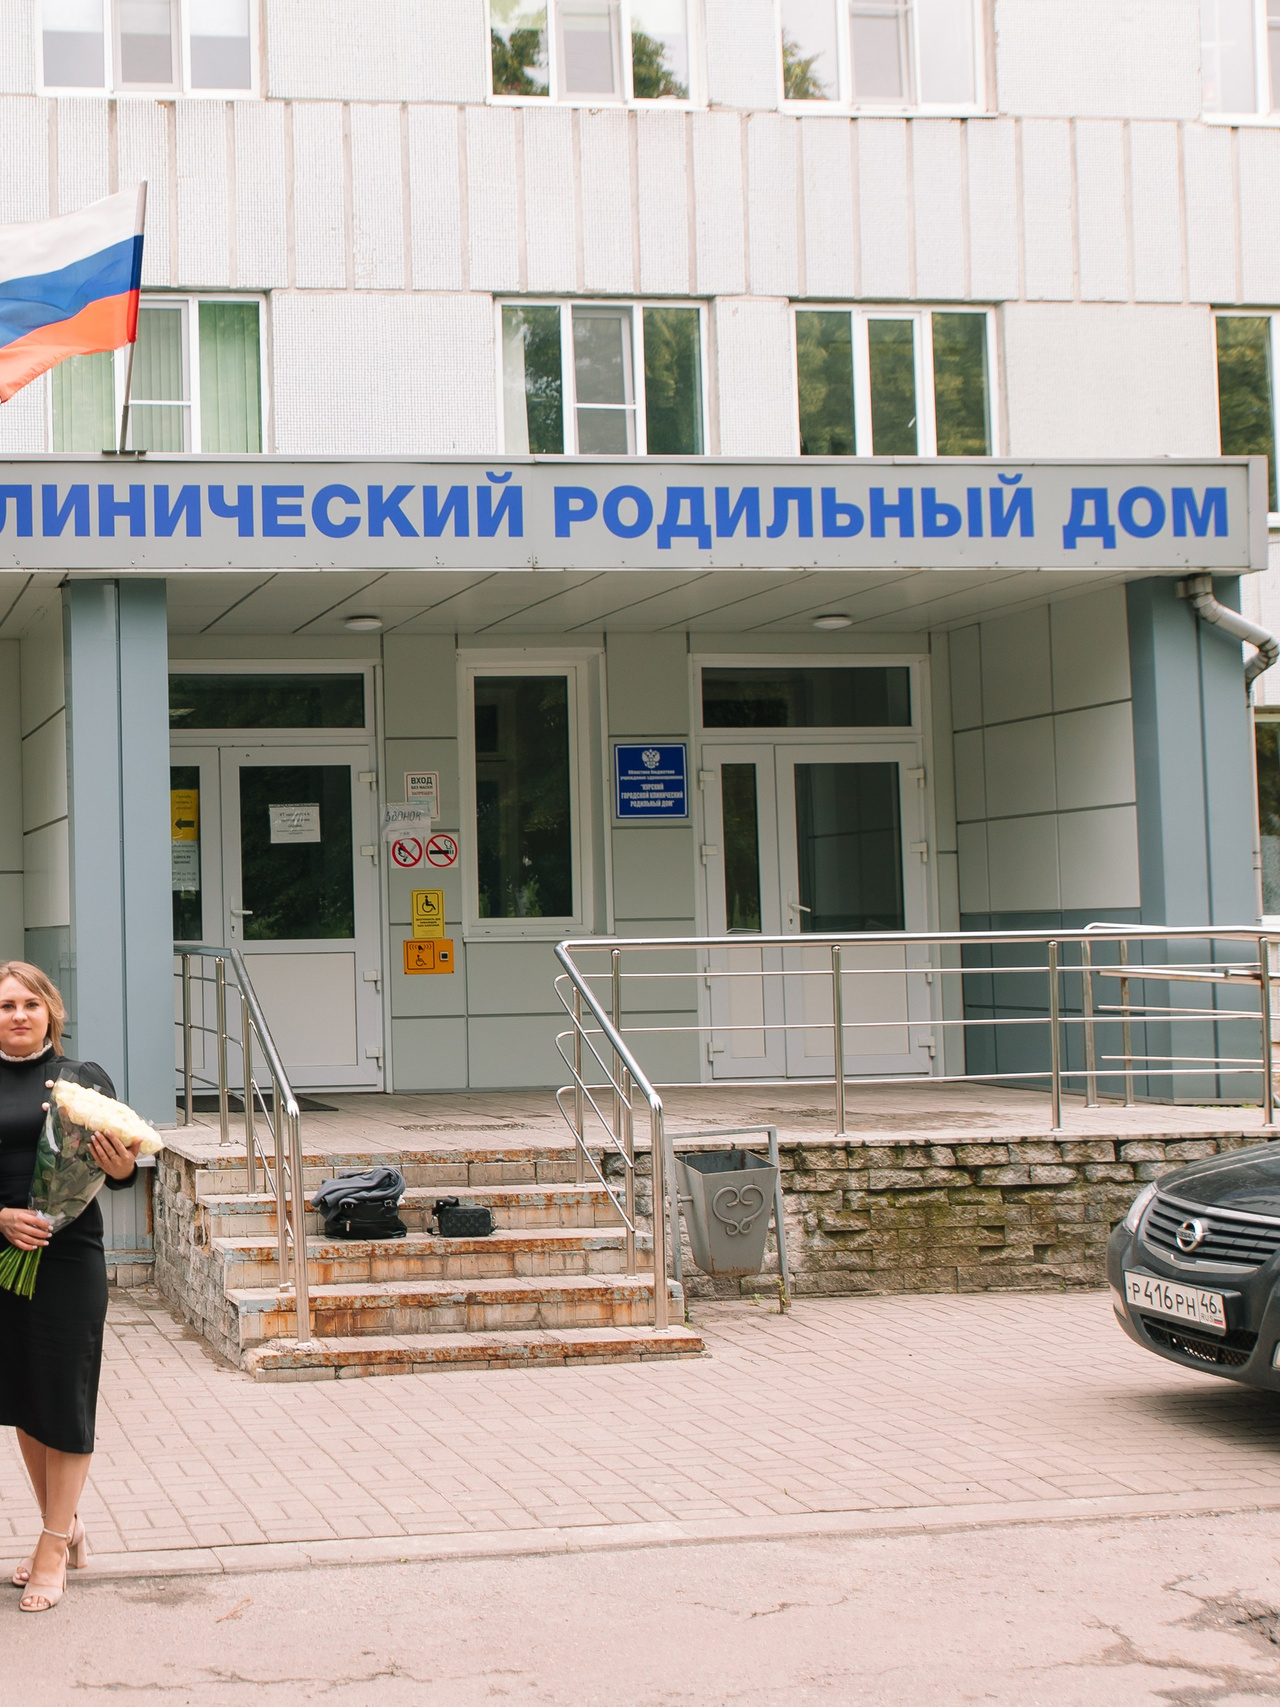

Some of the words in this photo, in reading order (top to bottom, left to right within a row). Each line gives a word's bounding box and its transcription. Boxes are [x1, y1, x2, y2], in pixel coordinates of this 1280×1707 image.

[554, 474, 1034, 549] РОДИЛЬНЫЙ
[1063, 486, 1228, 549] ДОМ
[1200, 1312, 1214, 1323] RUS
